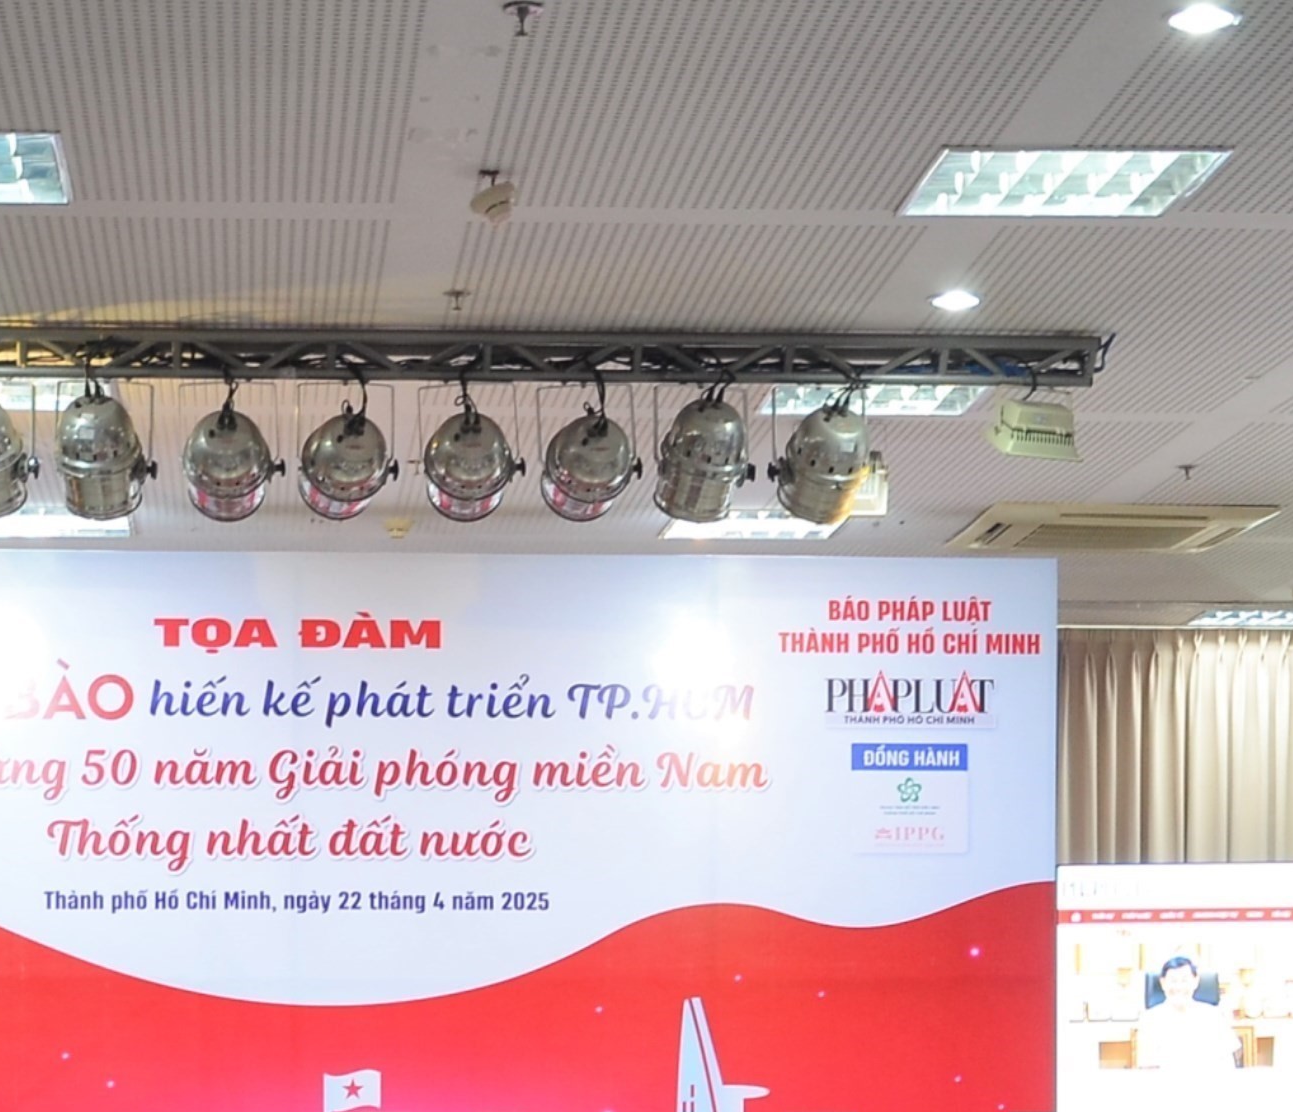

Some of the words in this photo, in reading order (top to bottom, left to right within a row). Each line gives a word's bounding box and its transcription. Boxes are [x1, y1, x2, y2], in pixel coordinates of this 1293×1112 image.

[828, 595, 870, 621] BÁO
[878, 595, 935, 622] PHÁP
[942, 596, 992, 625] LUẬT
[154, 617, 277, 654] TỌA
[297, 611, 442, 650] ĐÀM
[778, 627, 850, 653] THÀNH
[857, 627, 900, 654] PHỐ
[907, 627, 935, 654] HỒ
[942, 628, 978, 655] CHÍ
[985, 633, 1040, 655] MINH
[149, 675, 250, 717] hiến
[261, 675, 322, 717] kế
[325, 679, 435, 728] phát
[446, 673, 556, 720] triển
[946, 715, 975, 725] MINH
[863, 744, 909, 766] ĐỒNG
[914, 746, 960, 766] HÀNH
[81, 748, 139, 786] 50
[153, 747, 257, 786] năm
[268, 744, 365, 800] Giải
[374, 748, 520, 803] phóng
[532, 743, 646, 788] miền
[656, 751, 768, 788] Nam
[46, 814, 191, 872] Thống
[206, 814, 316, 856] nhất
[329, 814, 408, 856] đất
[419, 820, 532, 857] nước
[44, 890, 104, 910] Thành
[111, 889, 148, 914] phố
[155, 889, 179, 910] Hồ
[186, 890, 216, 910] Chí
[224, 890, 277, 913] Minh,
[283, 890, 331, 913] ngày
[338, 891, 362, 910] 22
[369, 890, 426, 913] tháng
[432, 891, 445, 910] 4
[452, 890, 495, 910] năm
[501, 891, 549, 911] 2025
